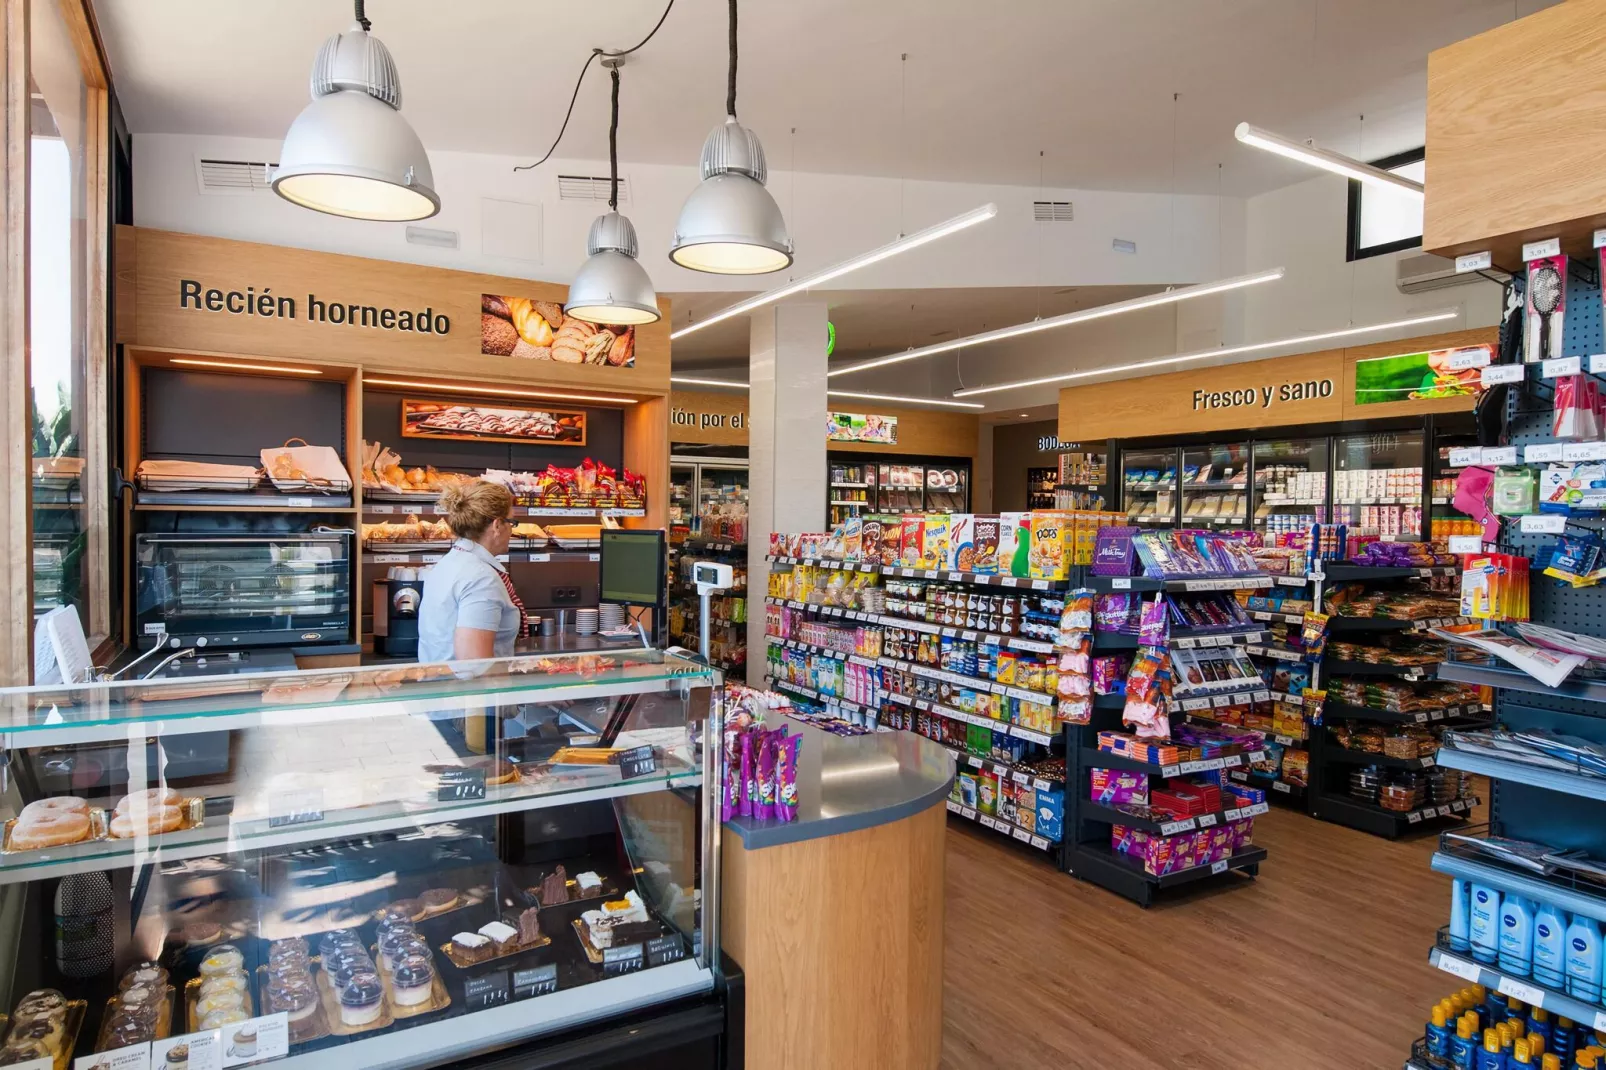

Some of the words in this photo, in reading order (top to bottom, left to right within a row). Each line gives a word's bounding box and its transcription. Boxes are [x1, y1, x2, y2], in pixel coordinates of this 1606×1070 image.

[180, 279, 296, 319] Recién
[307, 294, 451, 336] horneado
[1193, 387, 1257, 411] Fresco
[1261, 385, 1275, 409] y
[1279, 378, 1334, 402] sano
[671, 407, 696, 426] ión
[700, 412, 725, 430] por
[730, 412, 745, 429] el
[925, 524, 947, 538] Nesquik
[1099, 547, 1114, 556] Milk
